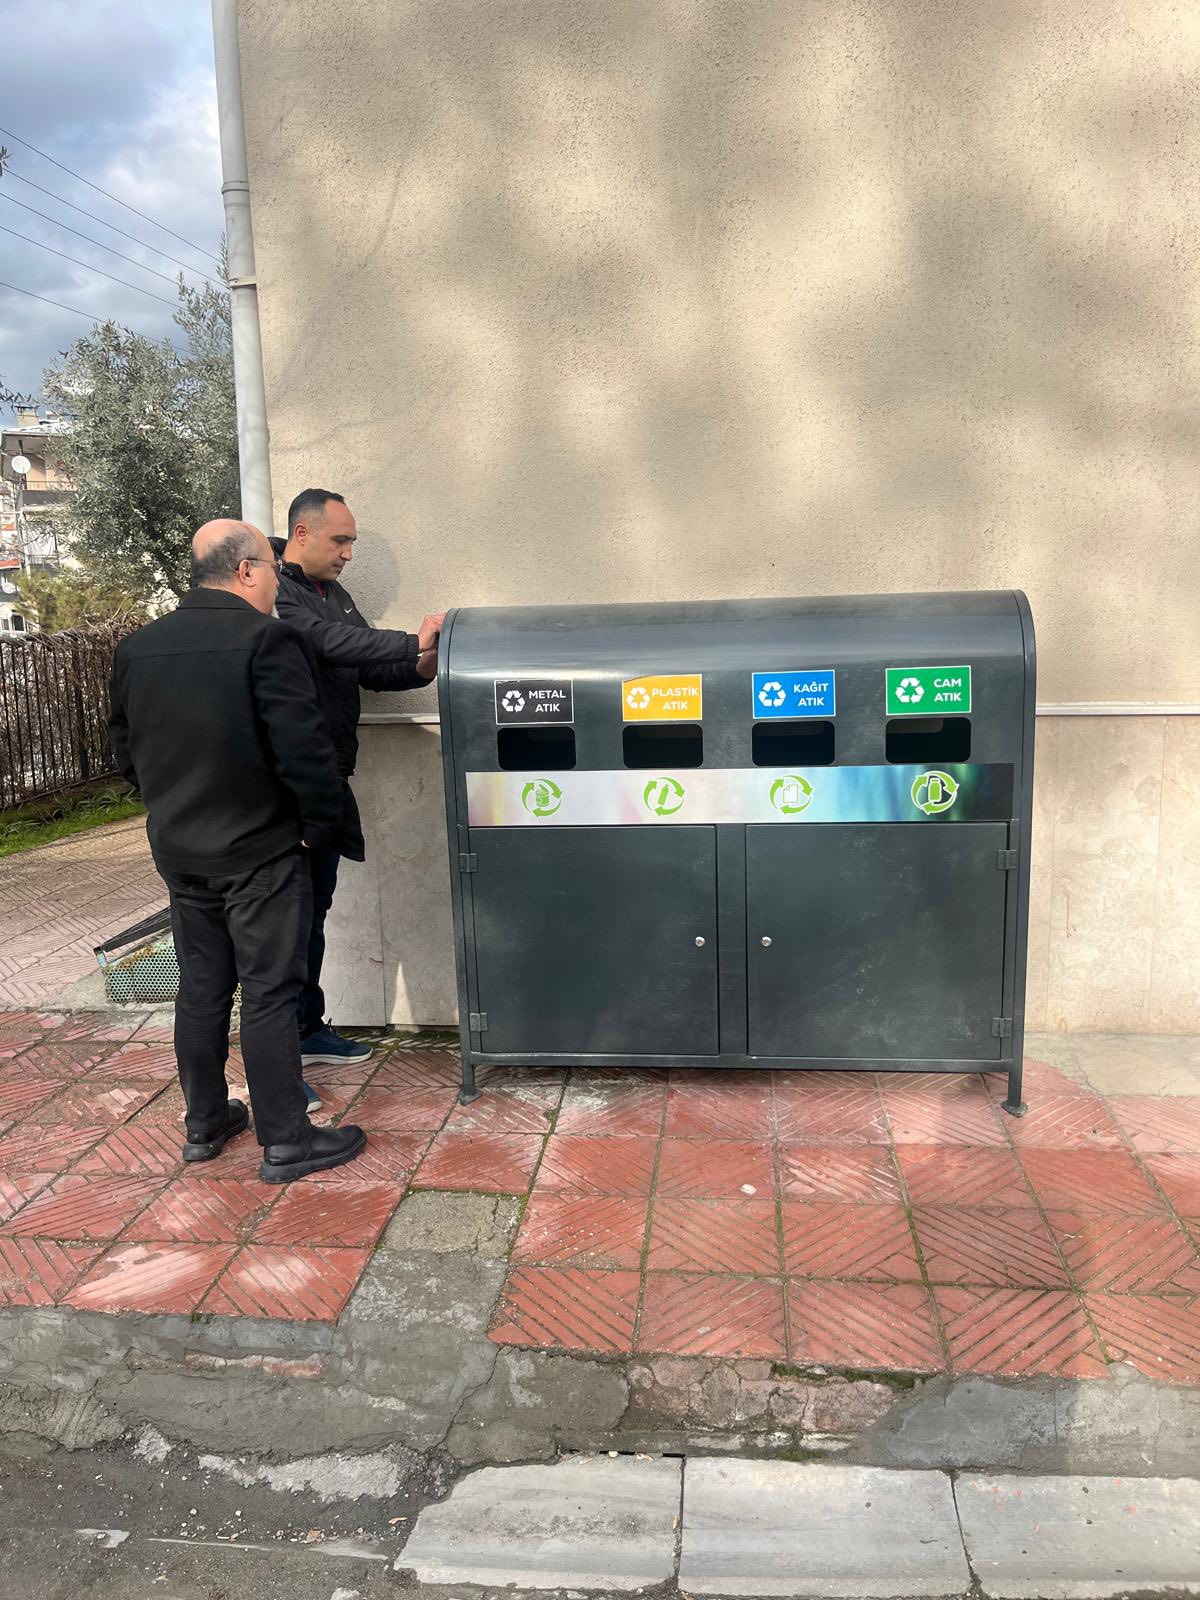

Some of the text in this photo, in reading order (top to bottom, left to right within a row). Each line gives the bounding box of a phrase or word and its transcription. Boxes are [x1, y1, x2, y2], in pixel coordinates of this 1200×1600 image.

[793, 681, 829, 693] KAĞIT
[933, 678, 962, 689] CAM
[528, 690, 566, 699] METAL
[651, 685, 699, 697] PLASTİK
[797, 697, 825, 707] ATIK
[934, 692, 962, 702] ATIK
[535, 703, 561, 713] ATIK
[662, 701, 688, 711] ATIK
